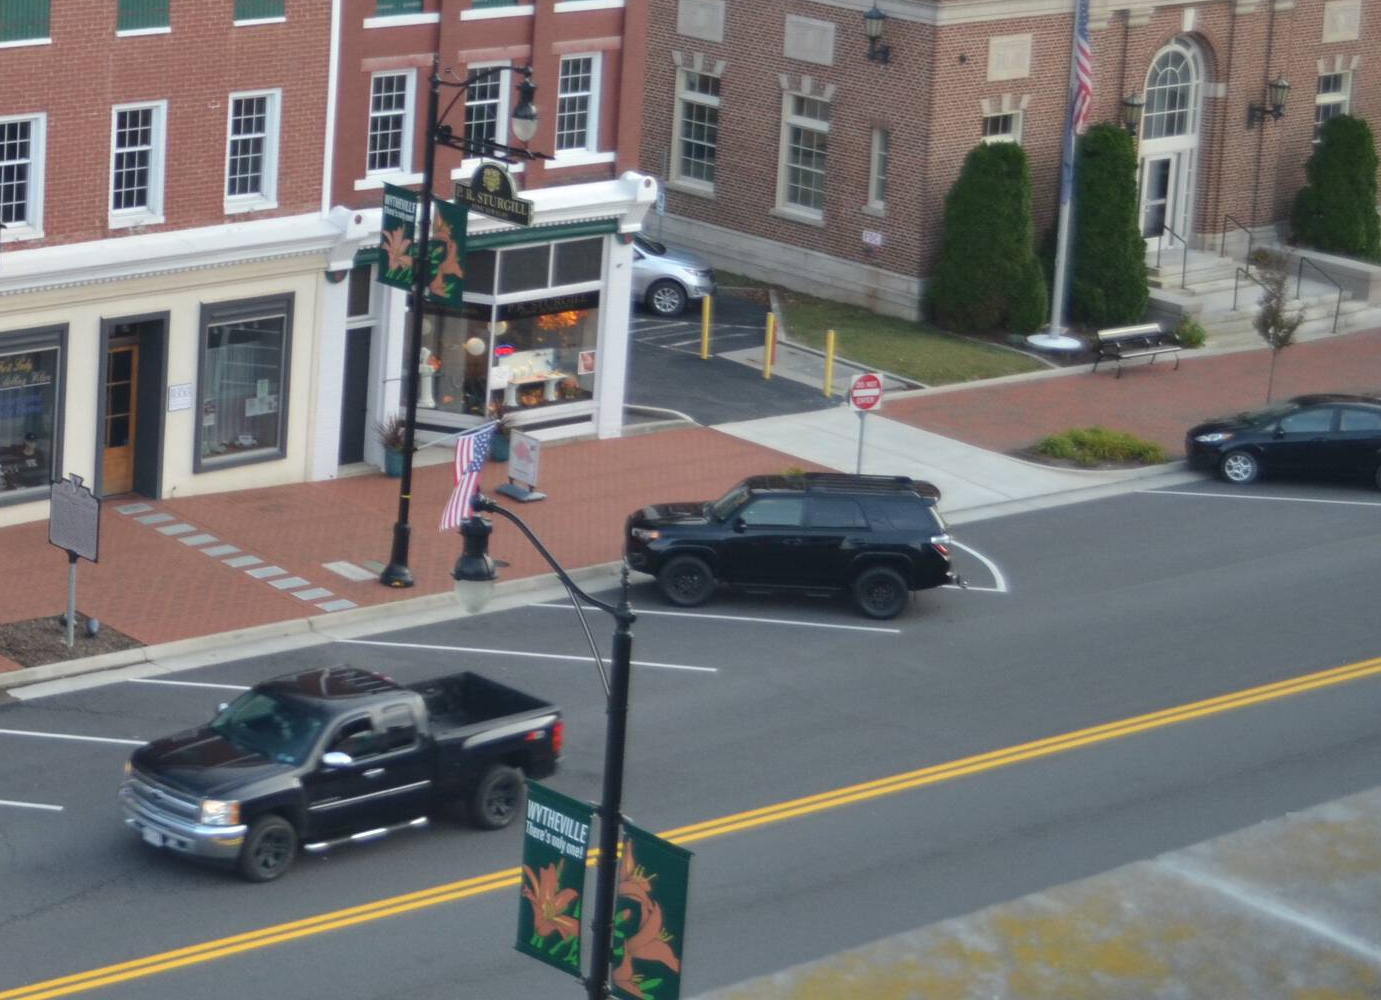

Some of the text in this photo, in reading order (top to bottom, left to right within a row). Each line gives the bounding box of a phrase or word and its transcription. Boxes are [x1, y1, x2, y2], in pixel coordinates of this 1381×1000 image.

[477, 192, 527, 215] STURGILL
[526, 820, 584, 859] There's only one!
[527, 799, 589, 844] WYTHEVILLE
